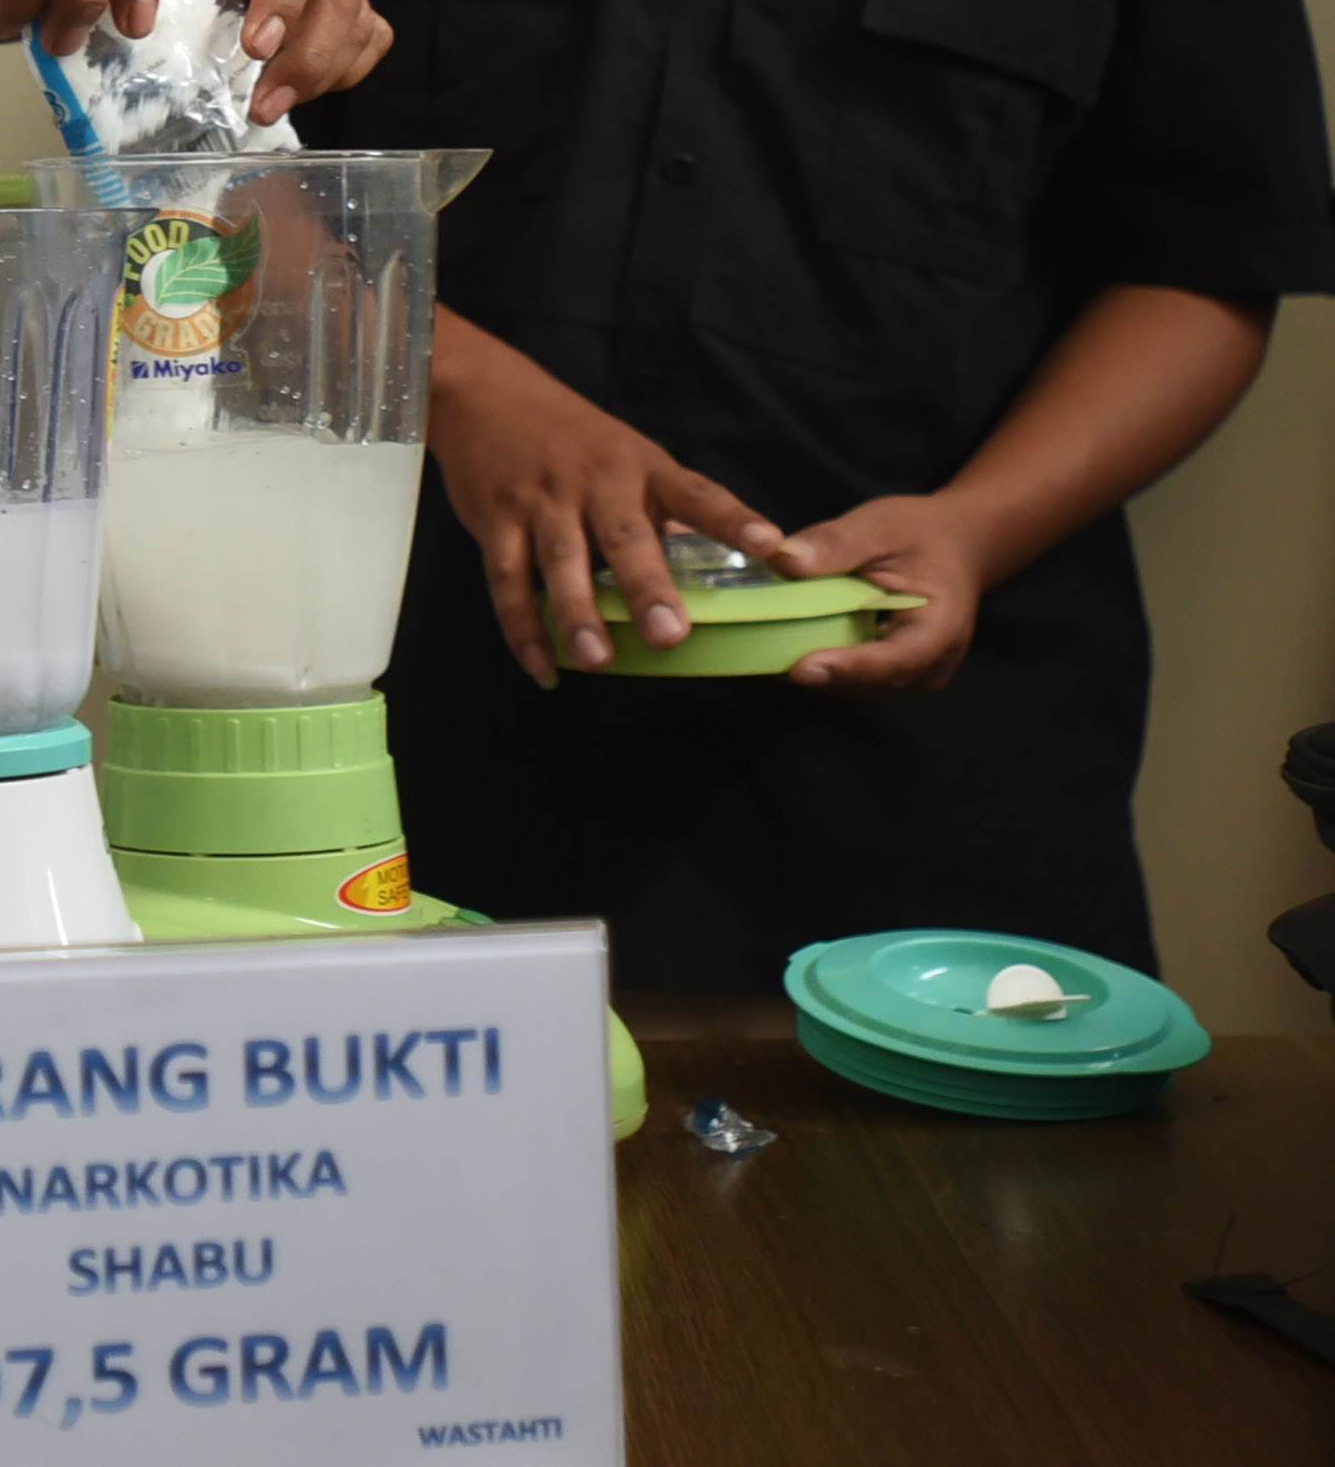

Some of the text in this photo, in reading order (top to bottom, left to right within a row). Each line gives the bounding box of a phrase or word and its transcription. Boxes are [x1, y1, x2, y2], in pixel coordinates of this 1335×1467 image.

[132, 301, 223, 351] GRAD
[153, 357, 243, 382] Miyako
[242, 1026, 505, 1110] BUKTI
[66, 1237, 276, 1298] SHABU
[167, 1322, 451, 1409] GRAM
[418, 1417, 564, 1449] WASTAHTI
